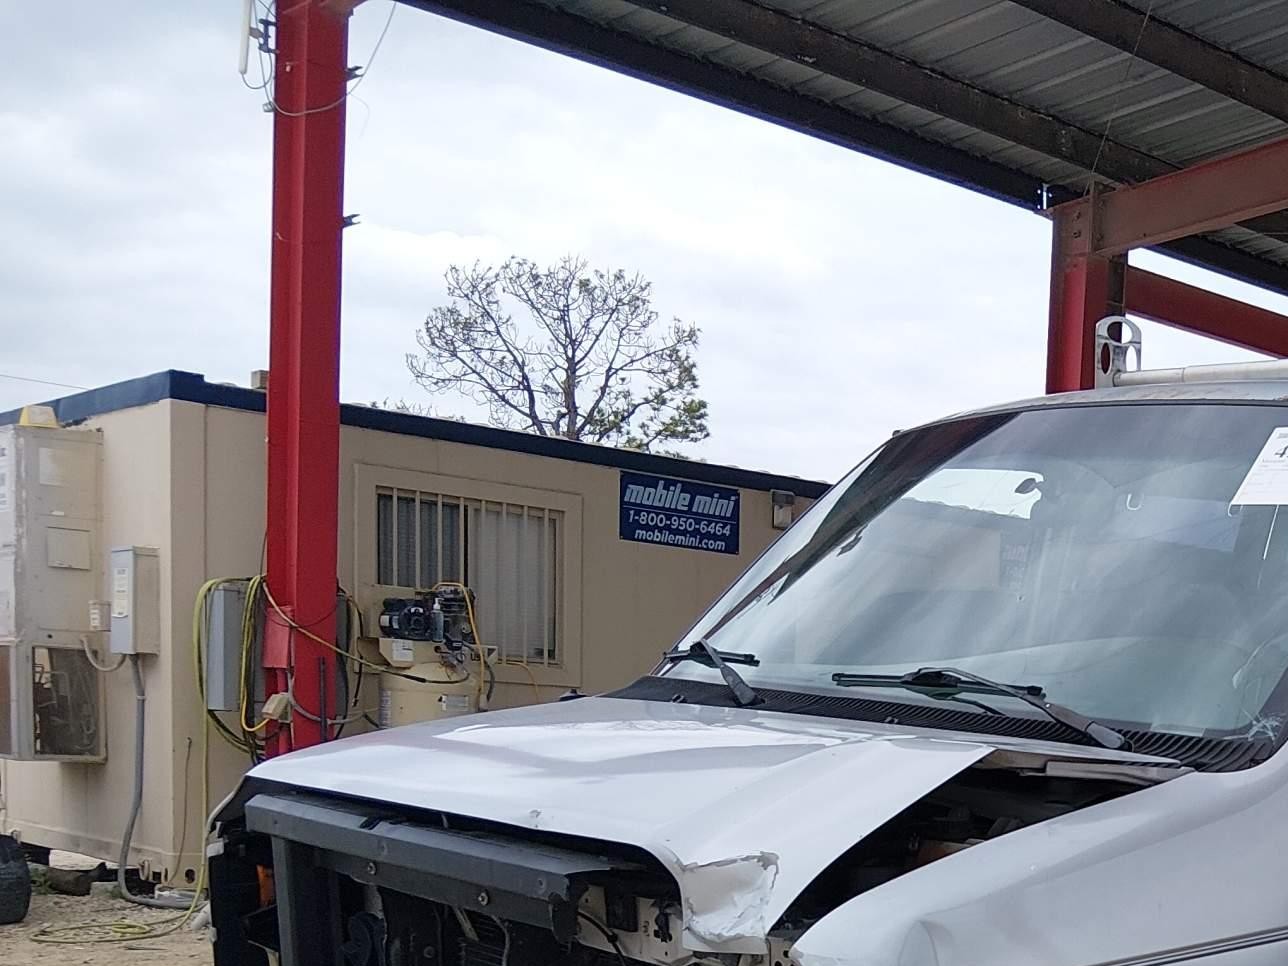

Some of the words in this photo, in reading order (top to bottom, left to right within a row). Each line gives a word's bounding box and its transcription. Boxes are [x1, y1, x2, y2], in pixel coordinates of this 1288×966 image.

[624, 480, 691, 511] mobile
[692, 493, 736, 517] mini
[628, 510, 731, 536] 1-800-950-6464
[634, 529, 726, 551] mobilemini.com
